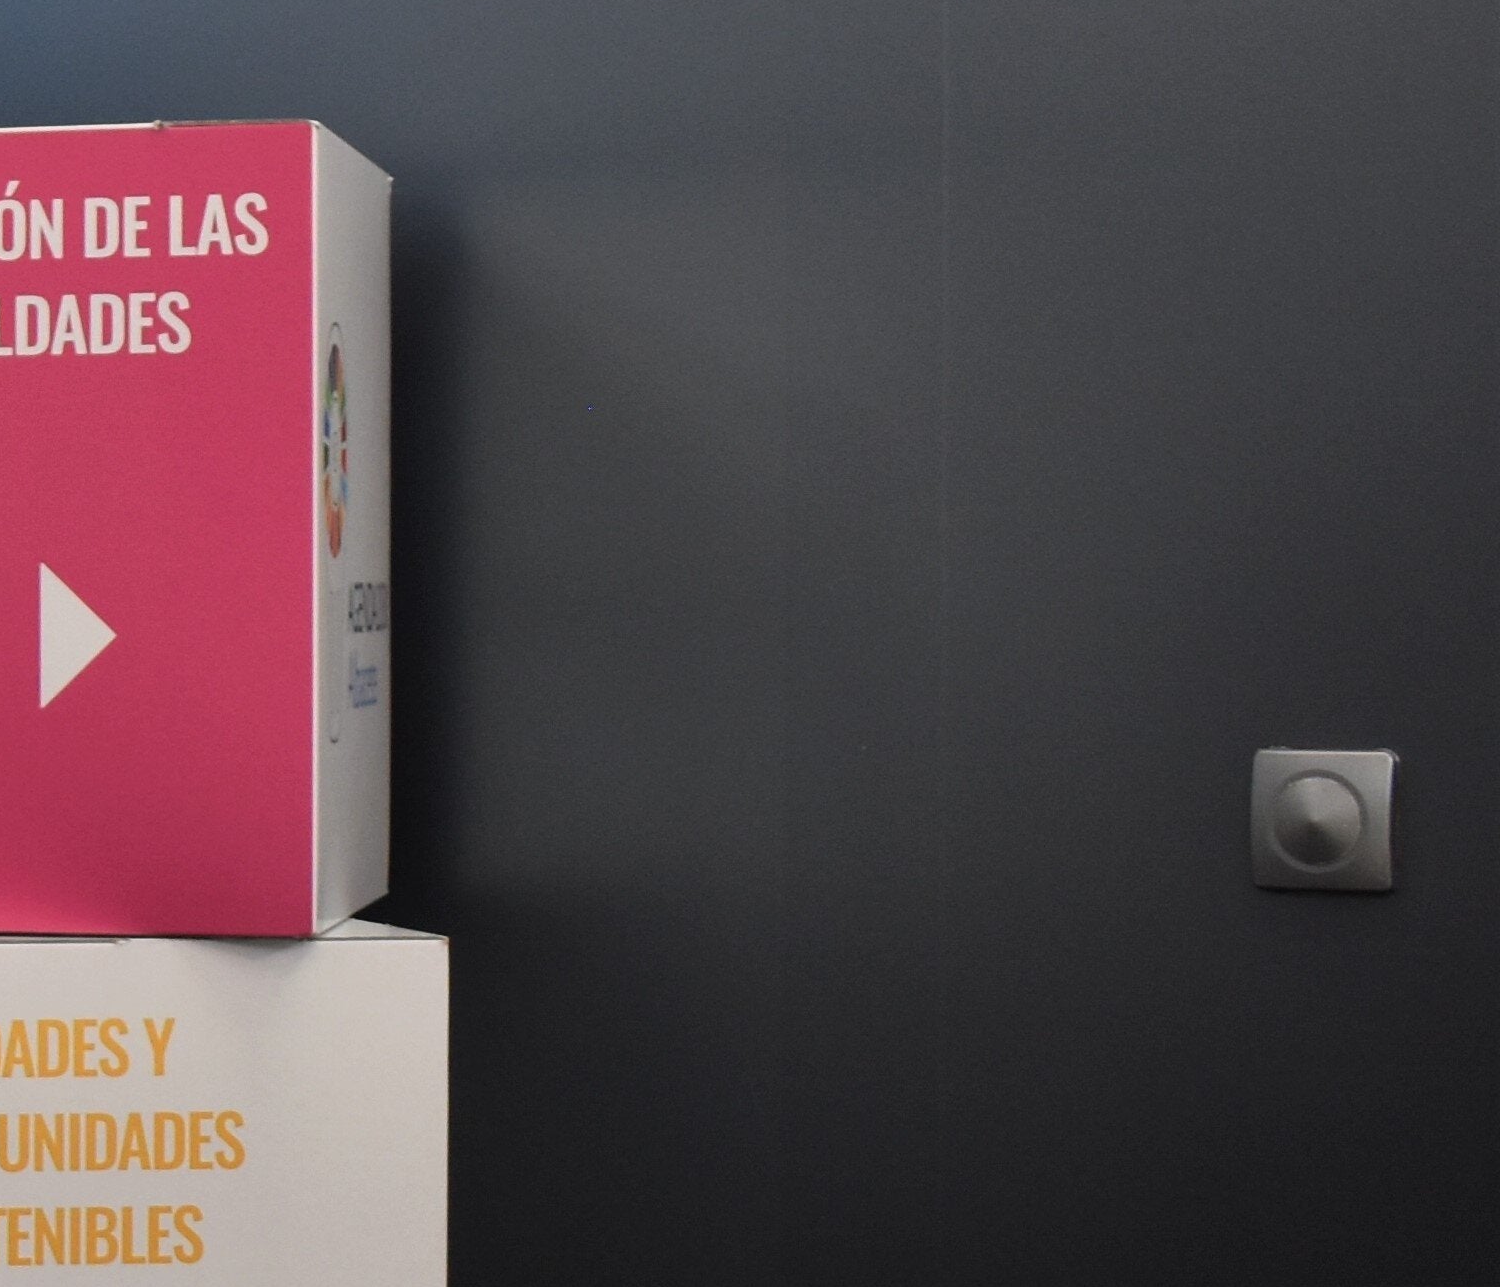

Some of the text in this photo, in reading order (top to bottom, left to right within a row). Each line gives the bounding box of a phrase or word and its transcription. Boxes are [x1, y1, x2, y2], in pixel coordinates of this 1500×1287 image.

[85, 196, 150, 258] DE
[169, 193, 269, 257] LAS
[144, 1018, 176, 1077] Y
